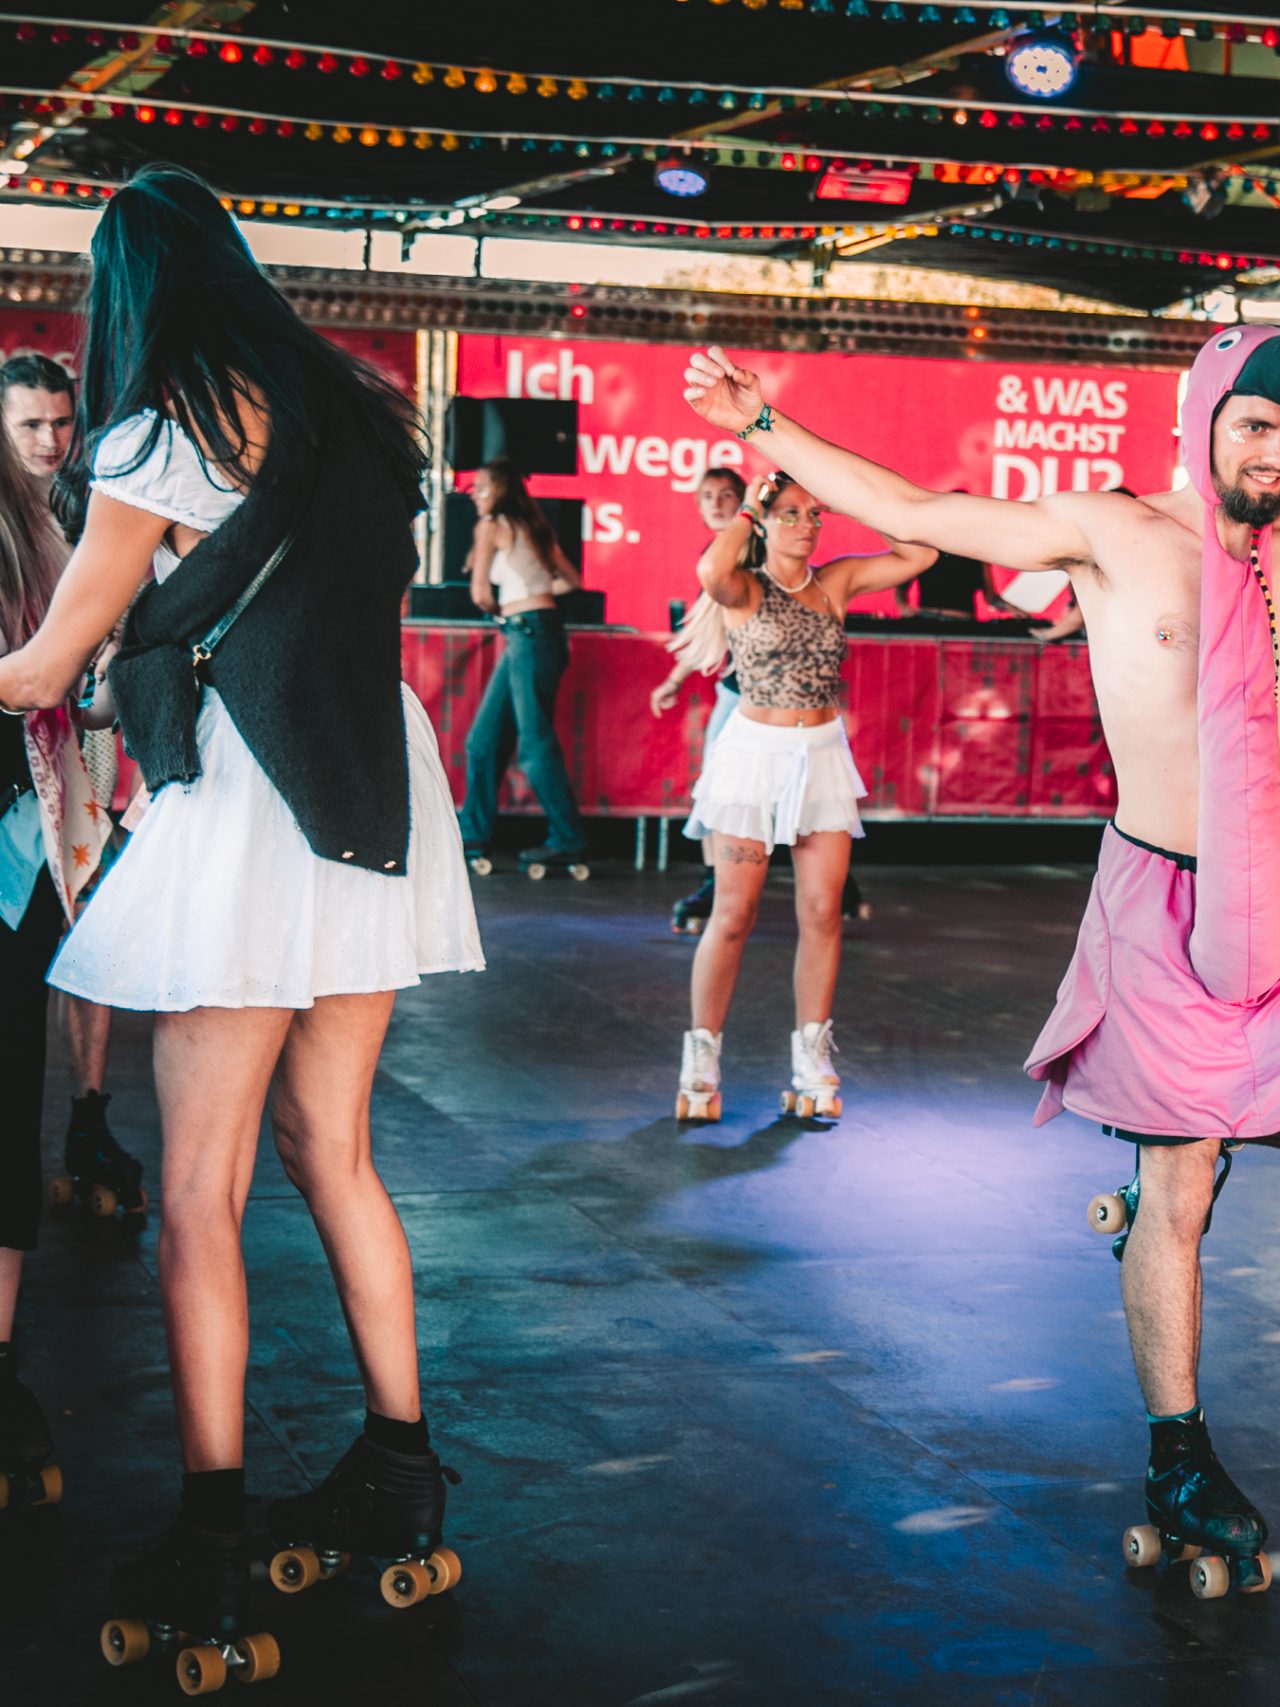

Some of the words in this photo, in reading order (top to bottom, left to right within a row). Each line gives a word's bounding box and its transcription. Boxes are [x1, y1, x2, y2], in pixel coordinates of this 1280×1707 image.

[507, 349, 594, 404] Ich
[996, 375, 1028, 413] &
[1032, 376, 1128, 419] WAS
[993, 418, 1126, 454] MACHST
[578, 433, 744, 492] wege
[991, 454, 1124, 501] DU?
